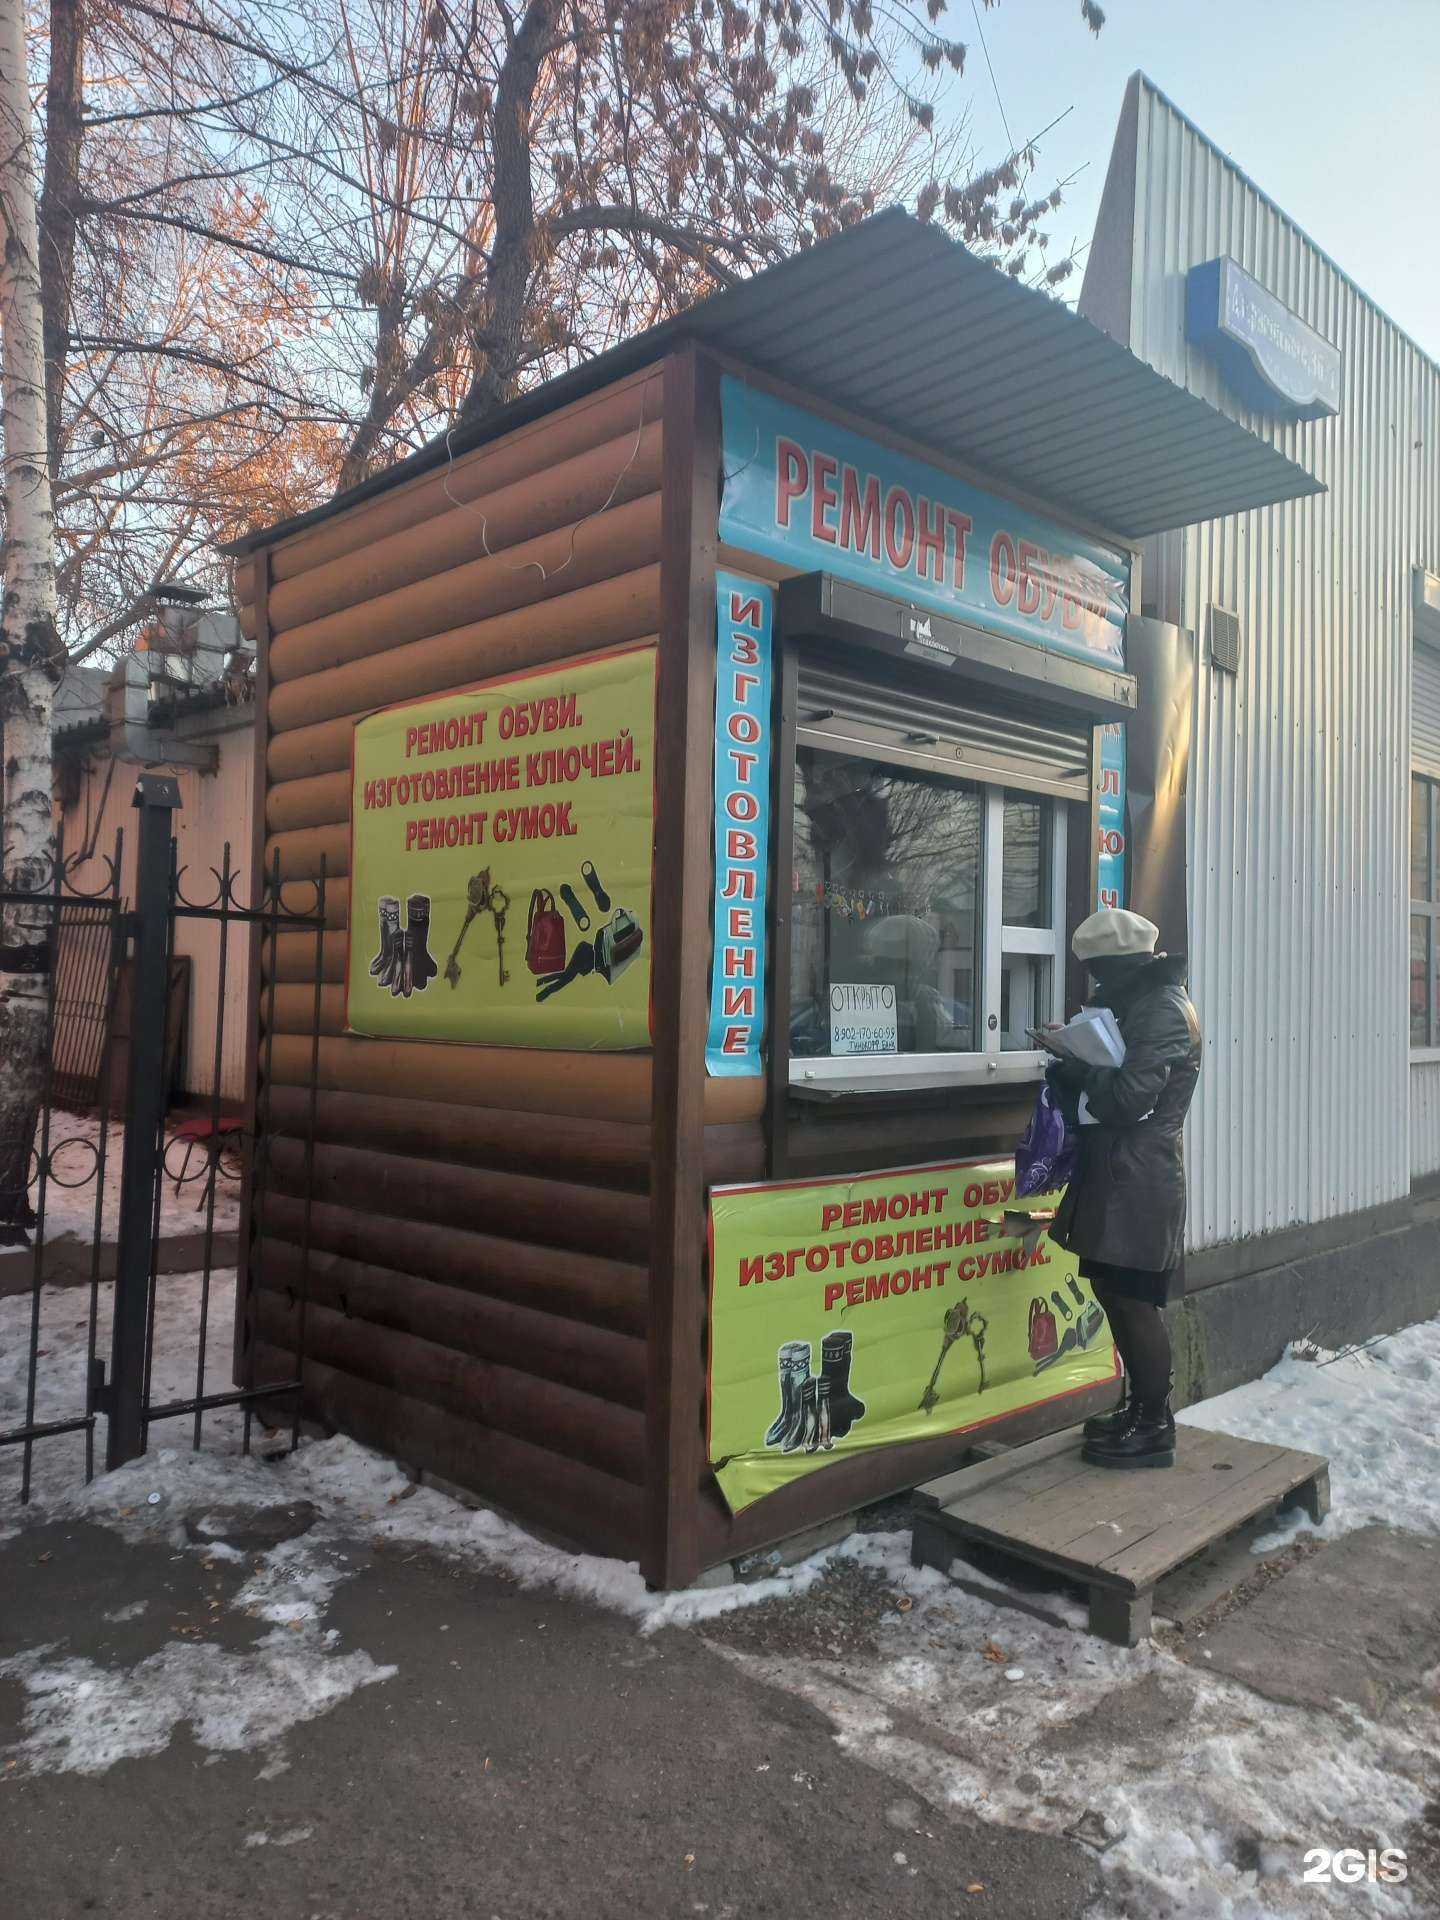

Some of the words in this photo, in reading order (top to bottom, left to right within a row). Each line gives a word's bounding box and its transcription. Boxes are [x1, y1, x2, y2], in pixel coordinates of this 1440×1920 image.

[775, 436, 972, 591] РЕМОНТ
[406, 711, 488, 758] РЕМОНТ
[498, 693, 583, 740] ОБУВИ.
[363, 756, 520, 810] ИЗГОТОВЛЕНИЕ
[525, 728, 641, 788] КЛЮЧЕЙ.
[405, 812, 488, 851] РЕМОНТ
[493, 801, 577, 843] СУМОК.
[721, 590, 765, 1056] ИЗГОТОВЛЕНИЕ
[831, 985, 894, 1012] ОТКРЫТО
[821, 1187, 949, 1232] РЕМОНТ
[738, 1218, 990, 1287] ИЗГОТОВЛЕНИЕ
[824, 1262, 951, 1311] РЕМОНТ
